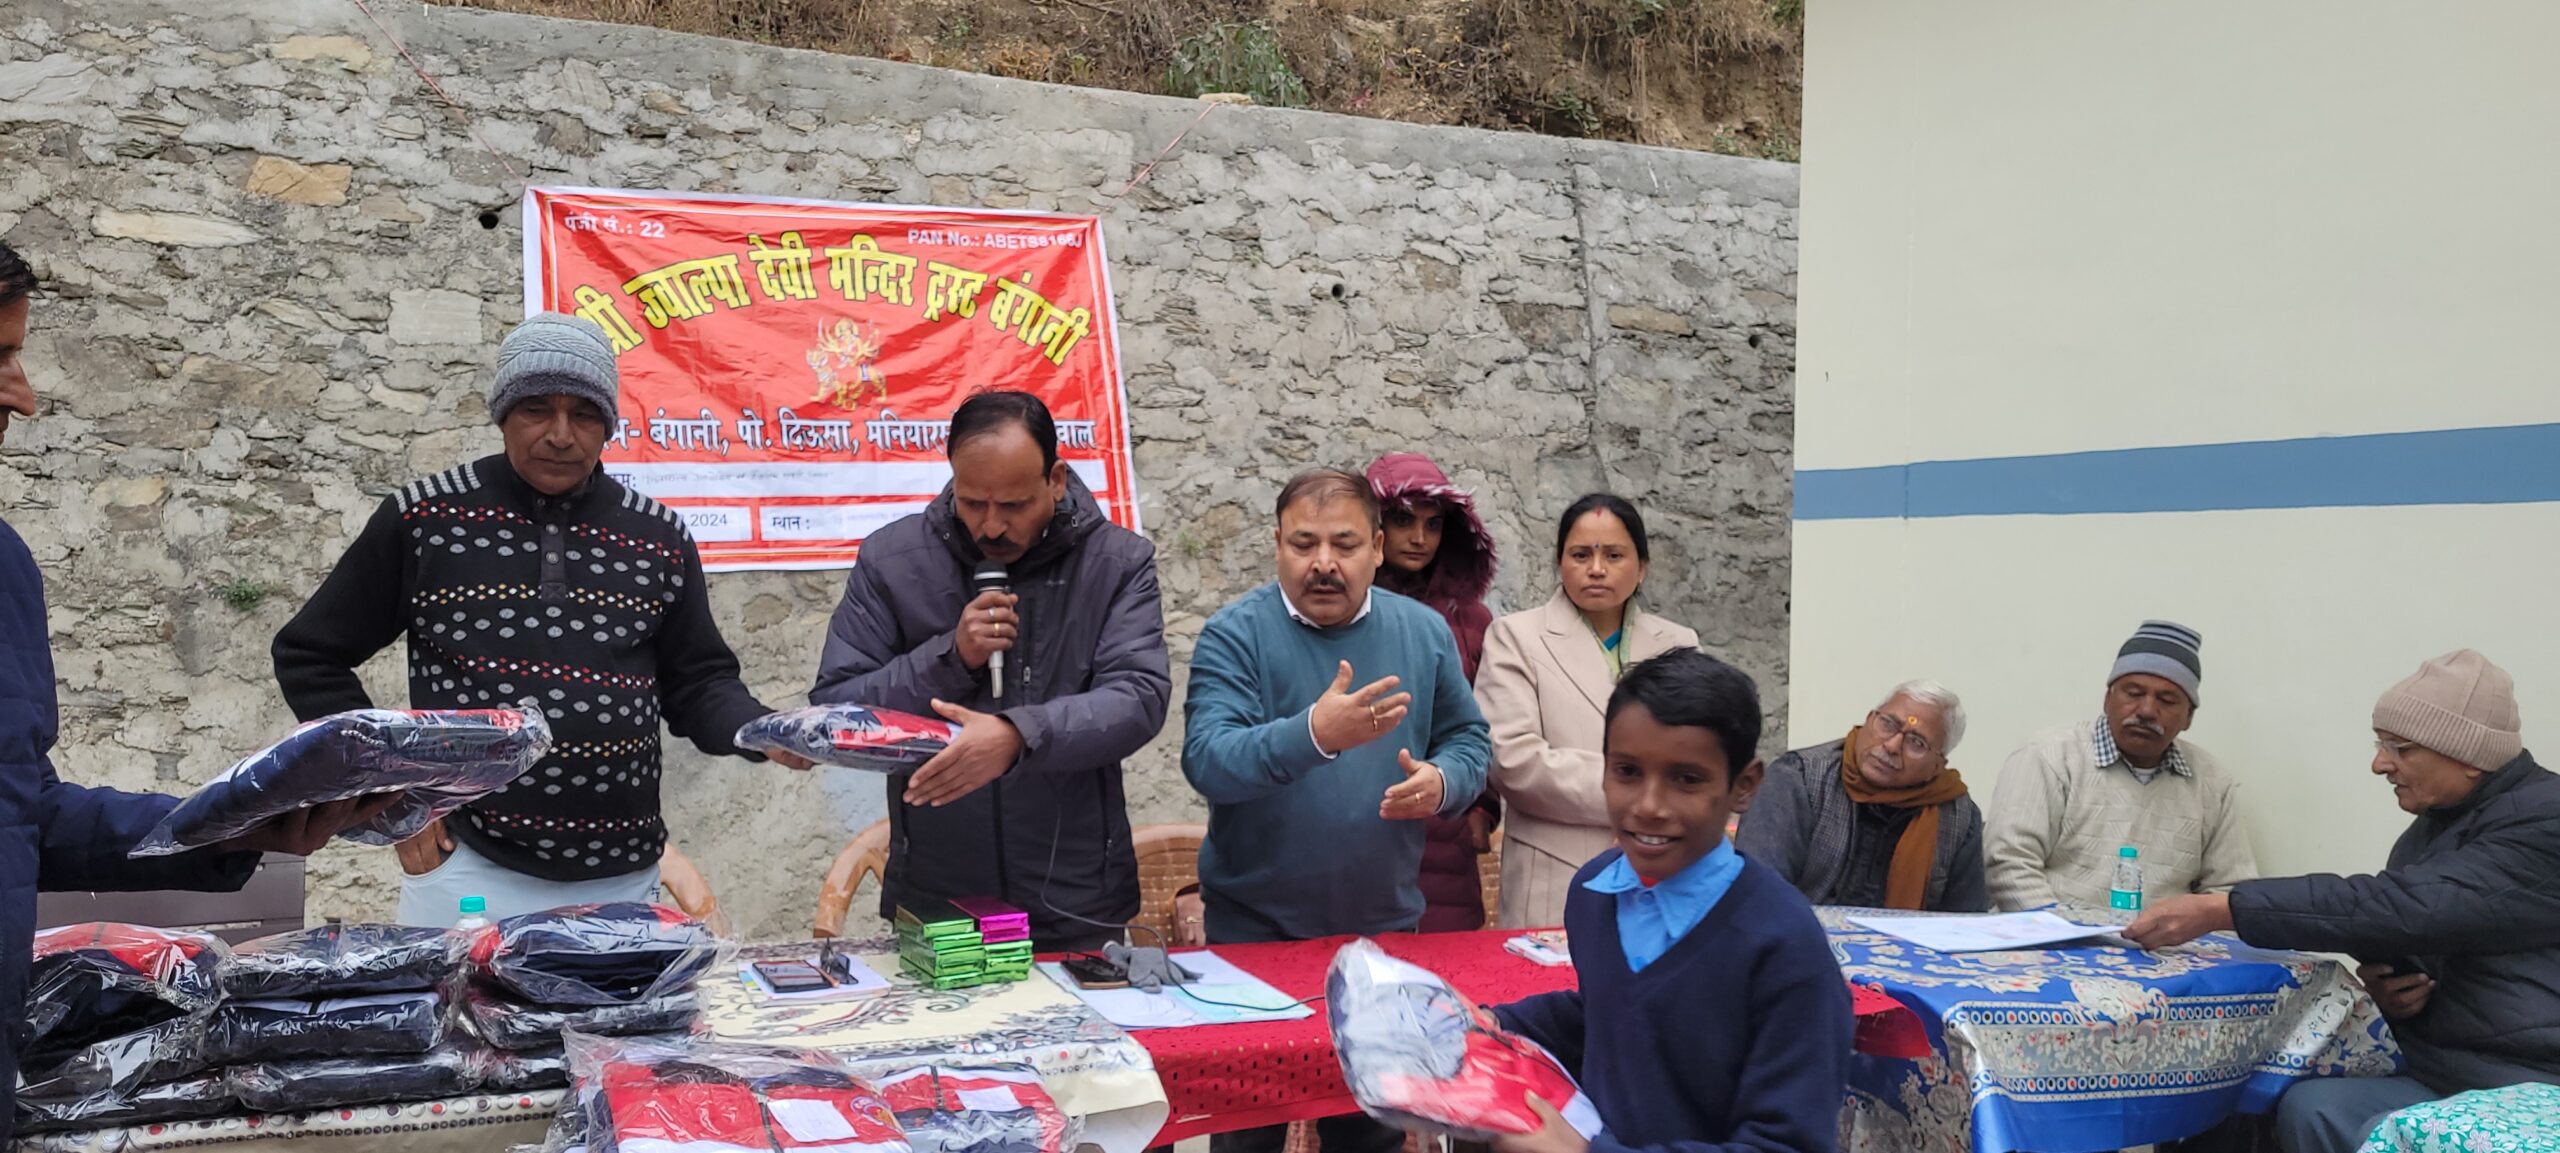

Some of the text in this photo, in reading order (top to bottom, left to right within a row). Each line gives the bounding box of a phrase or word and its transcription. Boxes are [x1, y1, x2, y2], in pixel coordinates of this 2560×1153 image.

[564, 211, 599, 233] पंजी
[640, 220, 665, 238] 22
[908, 229, 943, 246] PAN
[948, 230, 981, 247] No.:
[621, 253, 751, 329] ज्वाल्पा
[748, 230, 818, 302] देवी
[824, 233, 919, 307] मन्दिर
[923, 260, 989, 322] ट्रस्ट
[989, 271, 1092, 368] बंगानी
[648, 407, 730, 456] बंगानी,
[736, 407, 773, 450] पो.
[777, 406, 861, 455] दिऊसा,
[1054, 419, 1097, 449] वाल
